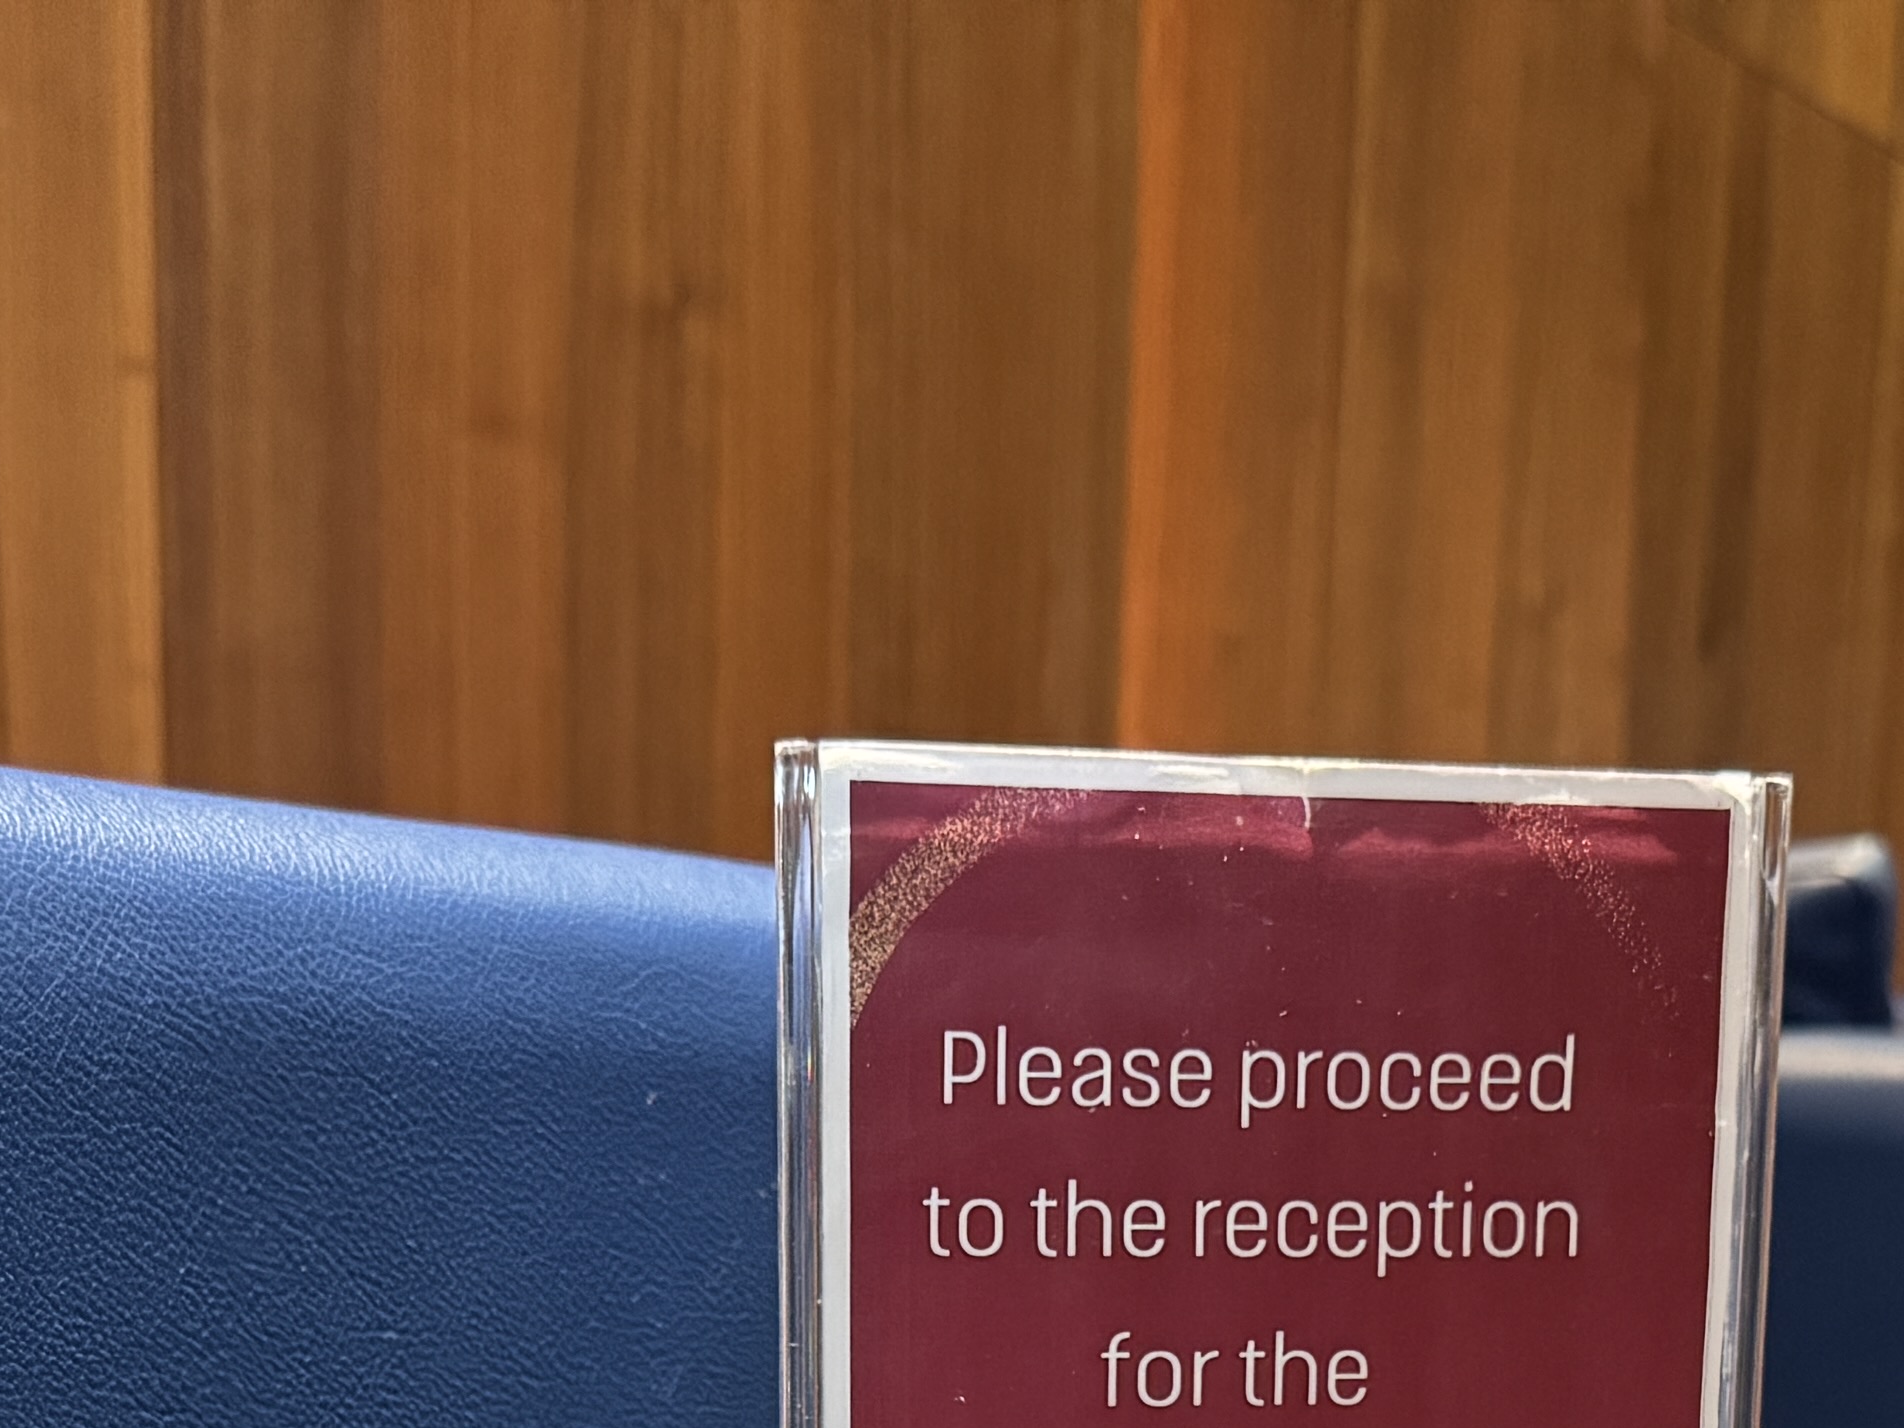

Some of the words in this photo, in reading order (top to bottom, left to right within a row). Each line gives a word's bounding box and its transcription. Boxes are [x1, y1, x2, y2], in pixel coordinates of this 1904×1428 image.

[942, 1024, 1214, 1109] Please
[1239, 1032, 1576, 1130] proceed
[921, 1185, 1005, 1258] to
[1028, 1177, 1167, 1259] the
[1194, 1178, 1580, 1279] reception
[1099, 1330, 1221, 1408] for
[1237, 1329, 1370, 1407] the
